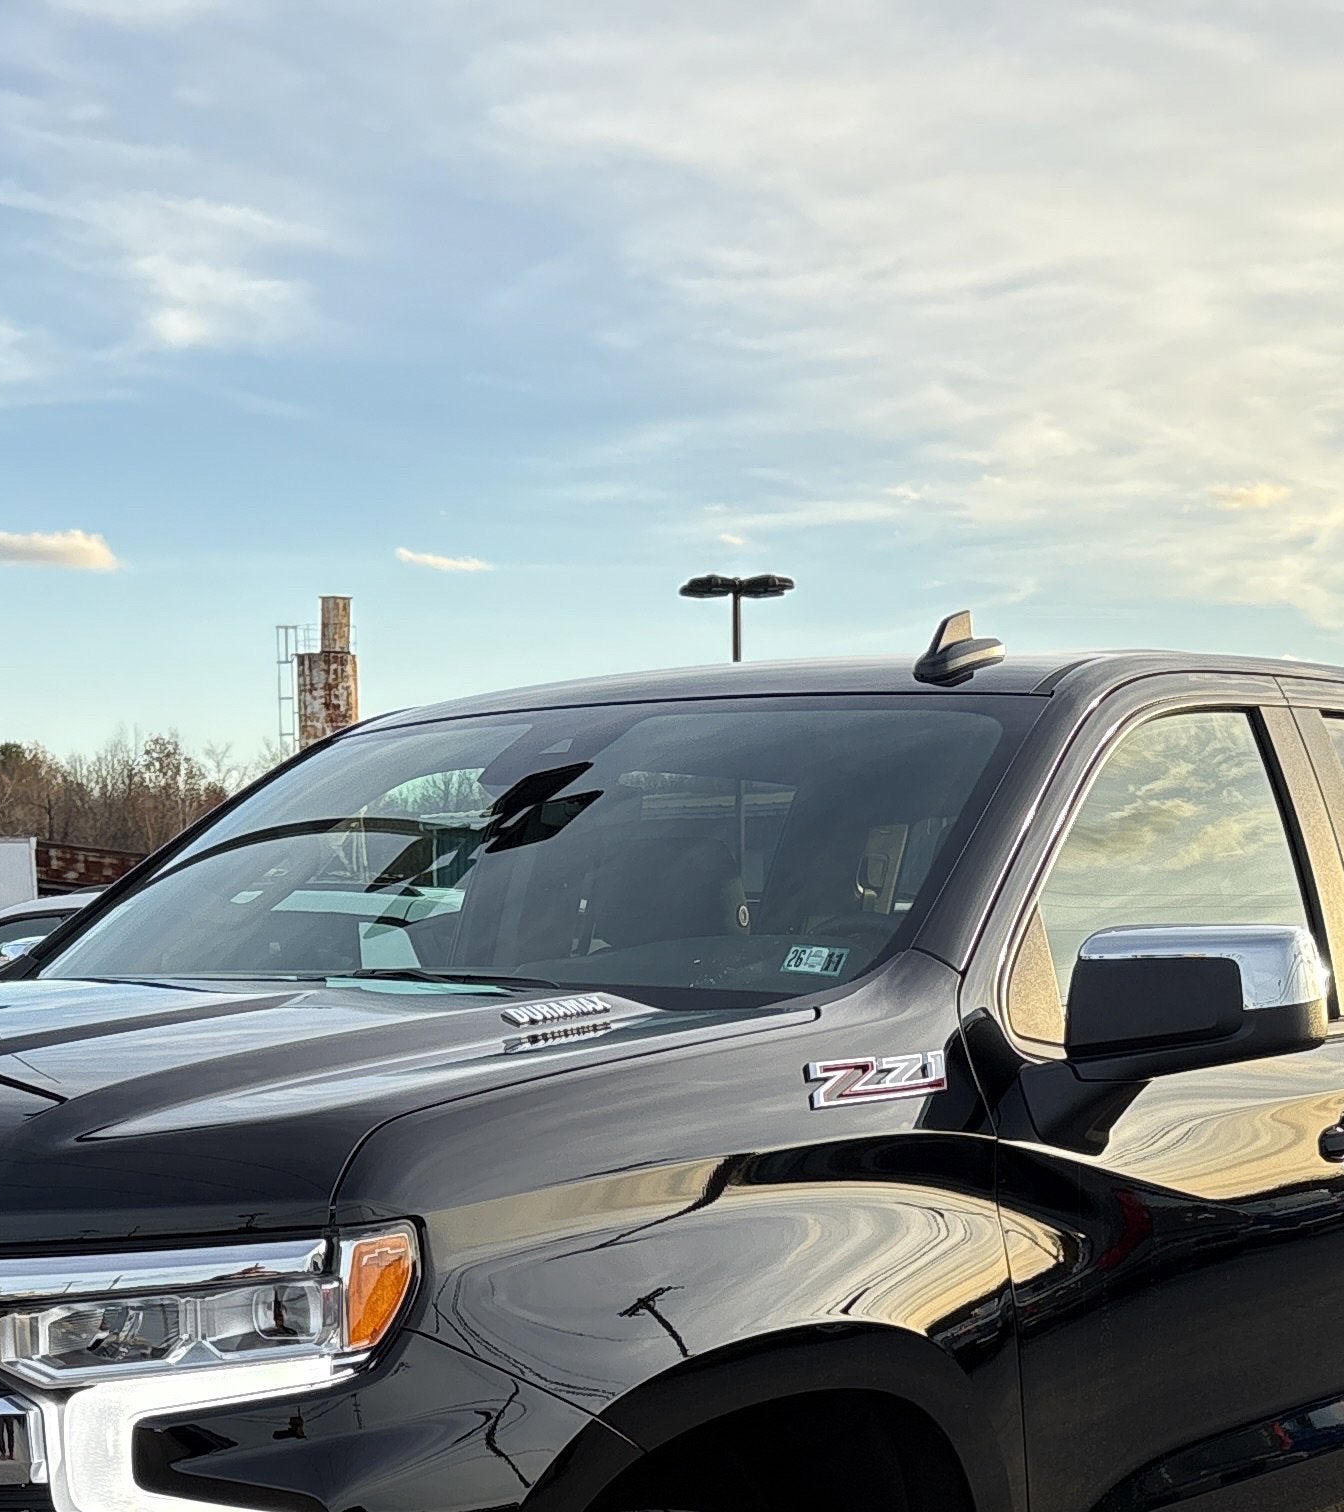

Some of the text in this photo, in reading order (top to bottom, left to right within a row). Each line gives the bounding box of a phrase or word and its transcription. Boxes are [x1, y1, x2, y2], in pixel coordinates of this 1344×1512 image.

[787, 949, 806, 968] 26
[503, 996, 612, 1024] DURAMAX
[804, 1050, 947, 1110] Z71
